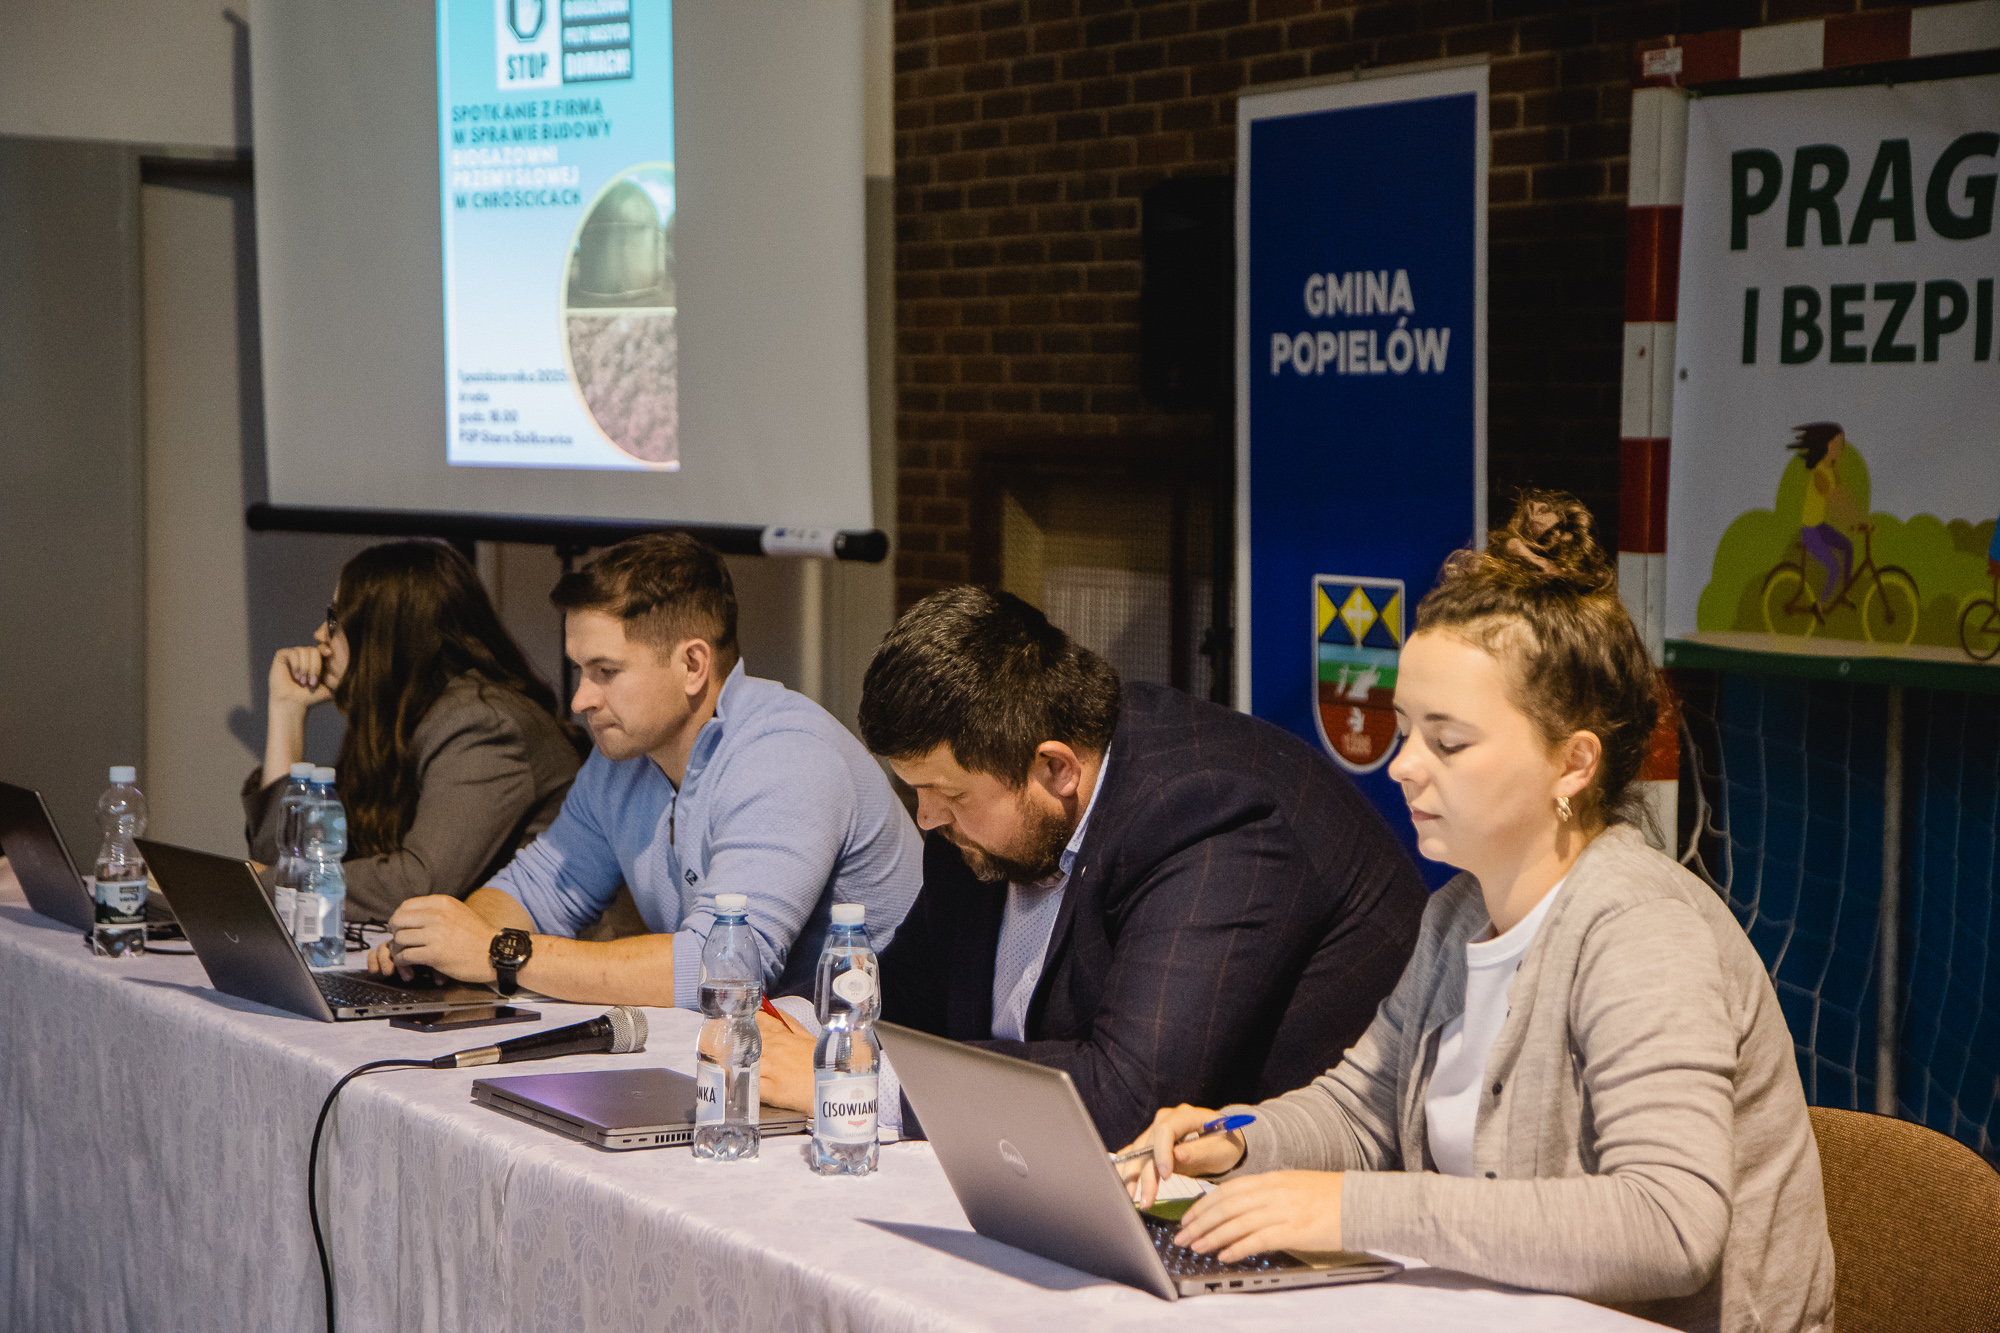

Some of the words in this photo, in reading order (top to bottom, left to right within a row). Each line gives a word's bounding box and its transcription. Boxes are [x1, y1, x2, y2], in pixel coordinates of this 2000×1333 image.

[508, 53, 548, 80] STOP
[451, 102, 537, 122] SPOTKANIE
[541, 101, 550, 118] Z
[471, 123, 538, 143] SPRAWIE
[542, 119, 613, 141] BUDOWY
[1731, 131, 2000, 251] PRAG
[1303, 268, 1416, 318] GMINA
[1270, 316, 1451, 376] POPIELÓW
[1742, 287, 1760, 364] I
[1780, 278, 2000, 364] BEZPI
